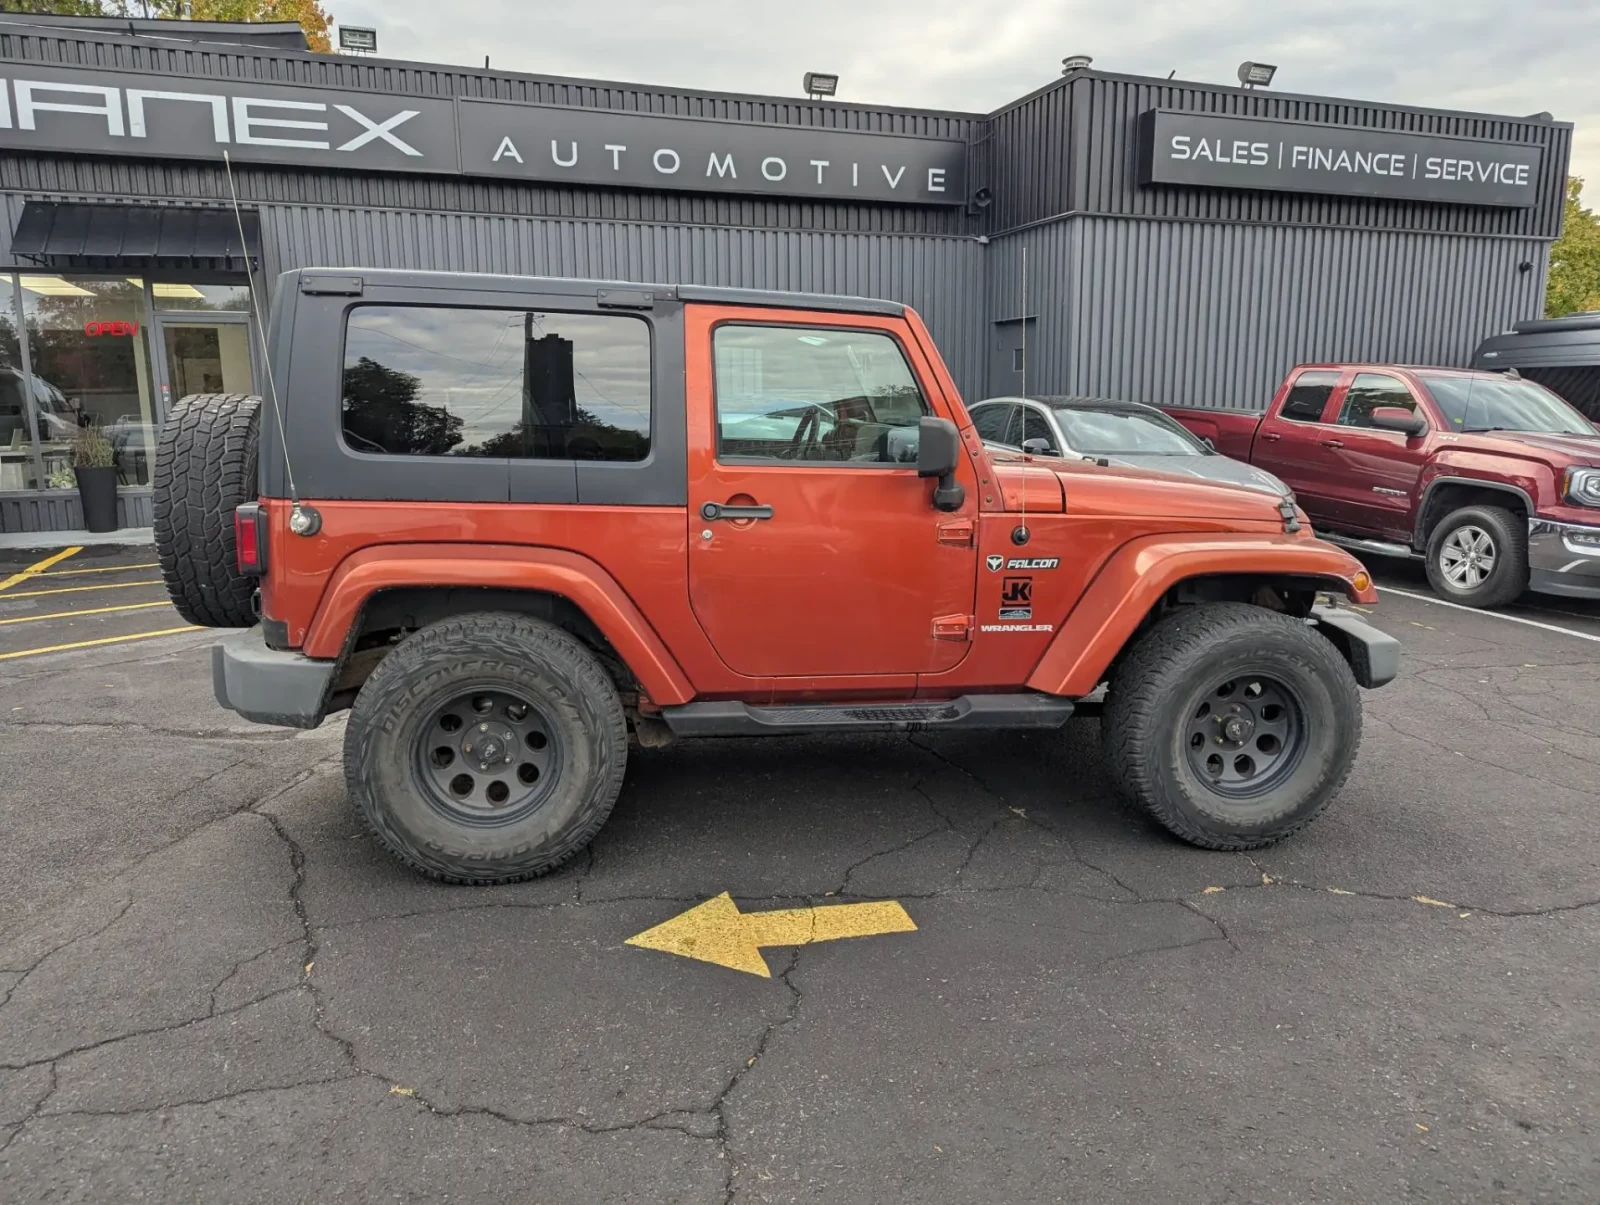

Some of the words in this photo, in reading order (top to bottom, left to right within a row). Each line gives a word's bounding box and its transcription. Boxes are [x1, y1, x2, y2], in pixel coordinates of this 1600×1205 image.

[491, 135, 948, 193] AUTOMOTIVE
[1170, 134, 1270, 167] SALES
[1291, 145, 1406, 178] FINANCE
[1424, 156, 1531, 187] SERVICE
[84, 320, 139, 337] OPEN
[1006, 558, 1059, 569] FALCON
[1002, 582, 1031, 601] JK
[980, 624, 1053, 632] WRANGLER
[381, 660, 540, 735] DISCOVERER
